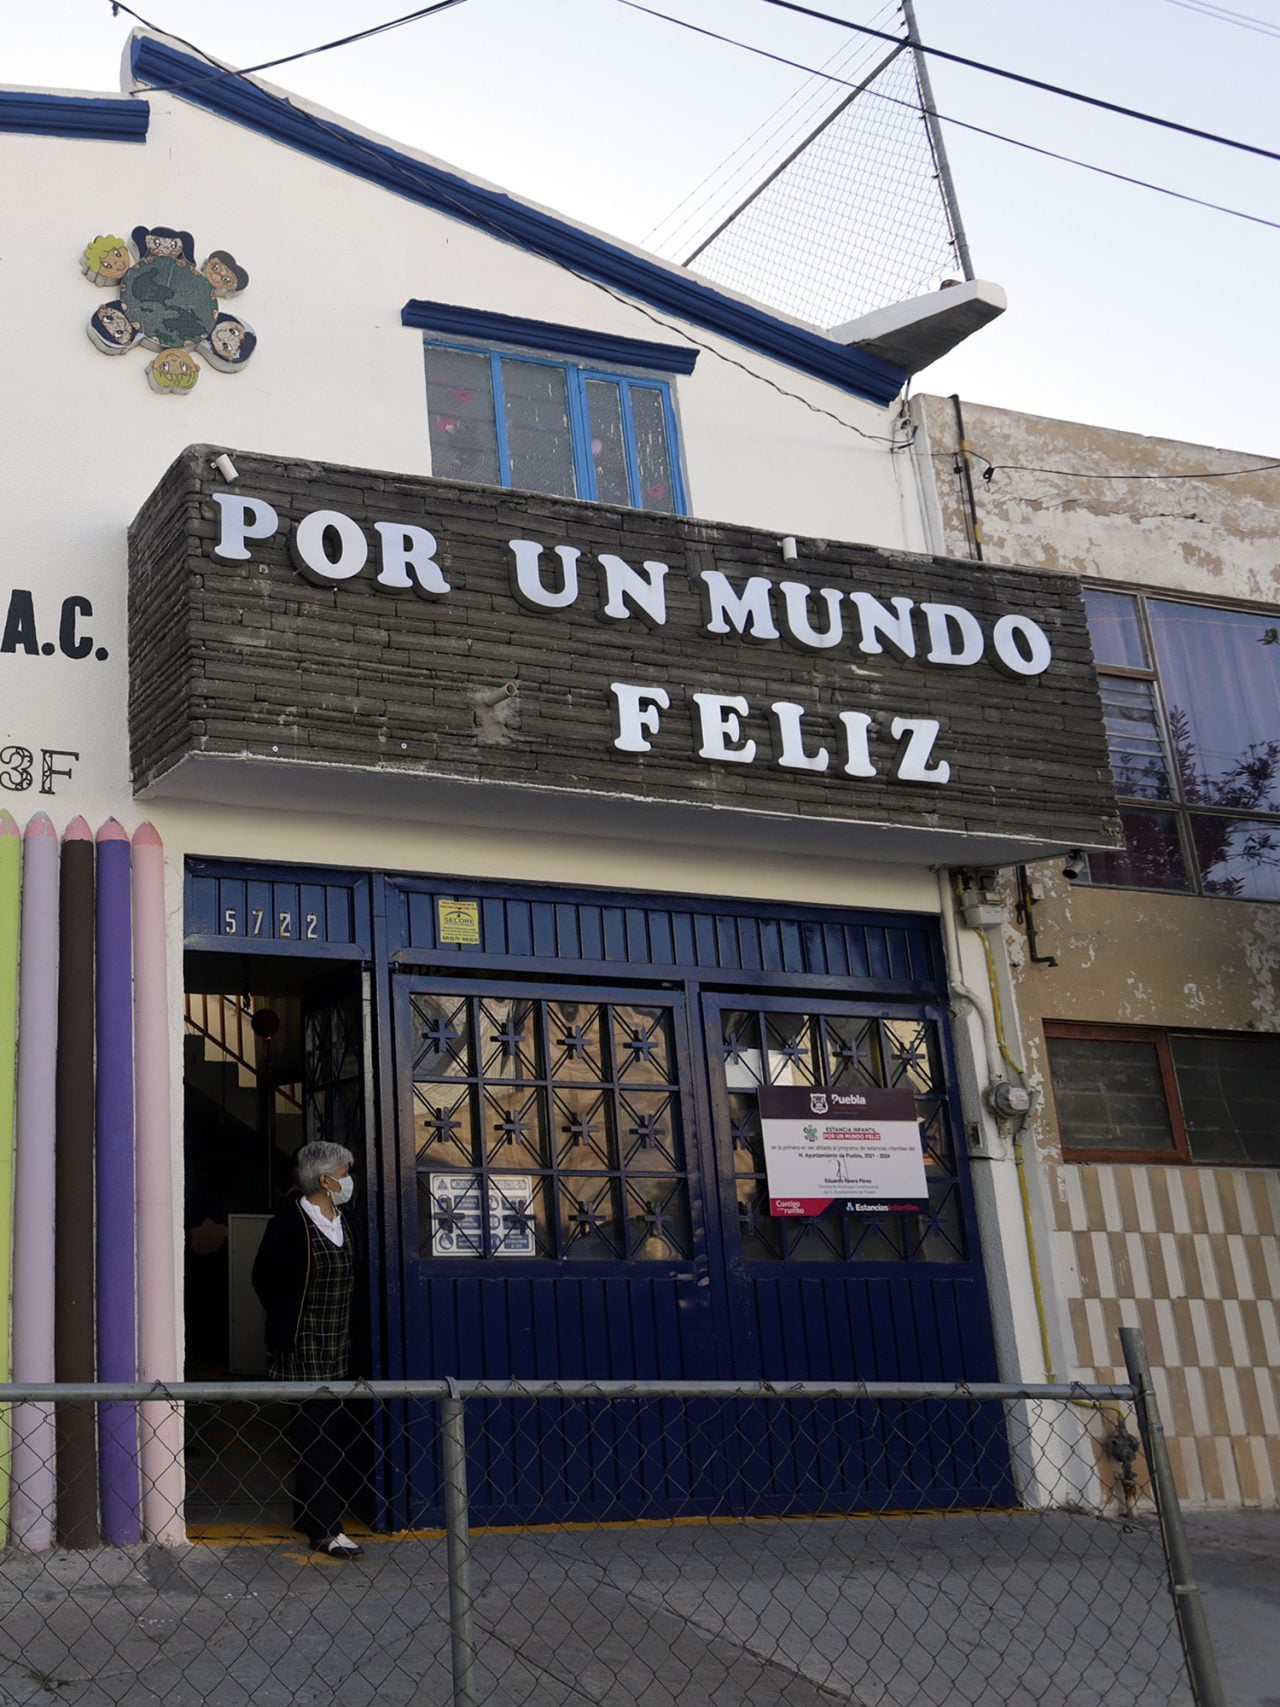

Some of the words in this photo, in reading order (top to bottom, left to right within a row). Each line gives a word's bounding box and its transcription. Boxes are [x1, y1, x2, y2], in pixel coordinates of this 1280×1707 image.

[210, 491, 452, 595] POR
[508, 538, 670, 630] UN
[700, 569, 1053, 677] MUNDO
[608, 681, 951, 785] FELIZ
[831, 1094, 867, 1105] Puebla
[776, 1199, 800, 1209] Contigo
